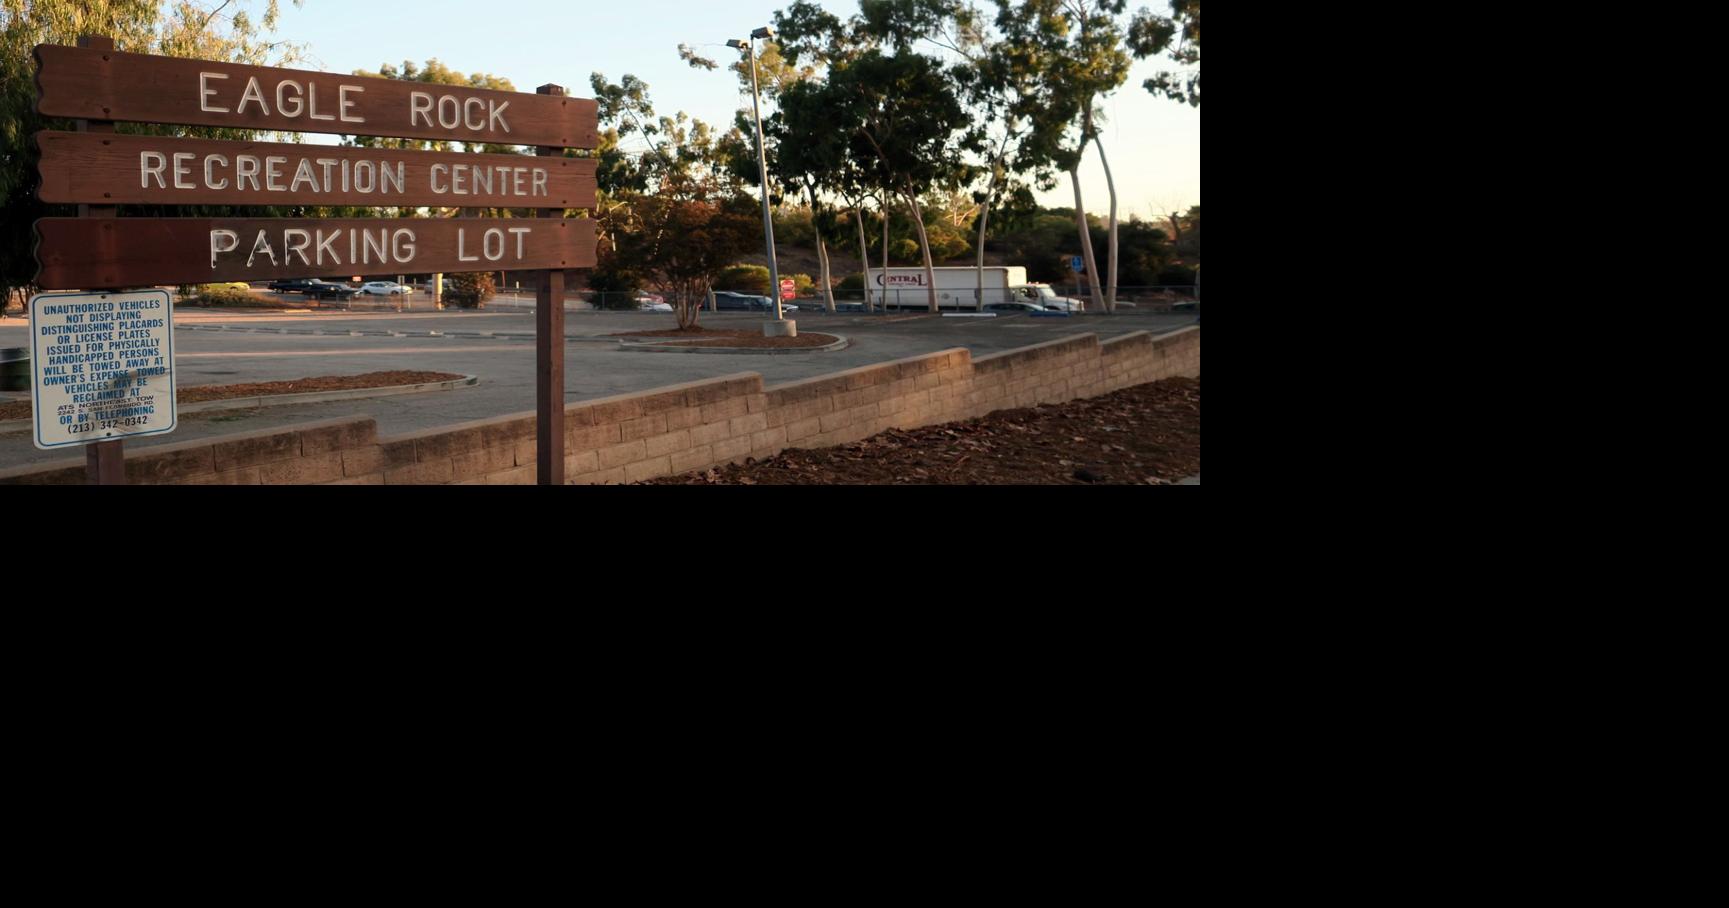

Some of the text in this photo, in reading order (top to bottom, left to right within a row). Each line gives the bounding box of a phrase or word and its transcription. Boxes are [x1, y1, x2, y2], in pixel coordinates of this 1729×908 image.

[200, 72, 510, 132] EAGLE ROCK
[141, 151, 548, 197] RECREATION CENTER
[210, 228, 532, 269] PARKING LOT
[44, 300, 160, 315] UNAUTHORIZED VEHICLES
[66, 311, 141, 323] NOT DISPLAYING
[41, 319, 163, 335] DISTINGUISHING PLACARDS
[57, 329, 150, 344] OR LICENSE PLATES
[47, 338, 160, 355] ISSUED FOR PHYSICALLY
[49, 348, 159, 365] HANDICAPPED PERSONS
[44, 357, 164, 376] WILL BE TOWED AWAY AT
[43, 374, 85, 386] OWNER'S
[137, 367, 165, 376] TOWED
[65, 377, 148, 394] VEHICLES MAY BE
[73, 388, 140, 403] RECLAIMED AT
[59, 406, 154, 424] OR BY TELEPHONING
[67, 416, 148, 434] (213) 342-0342
